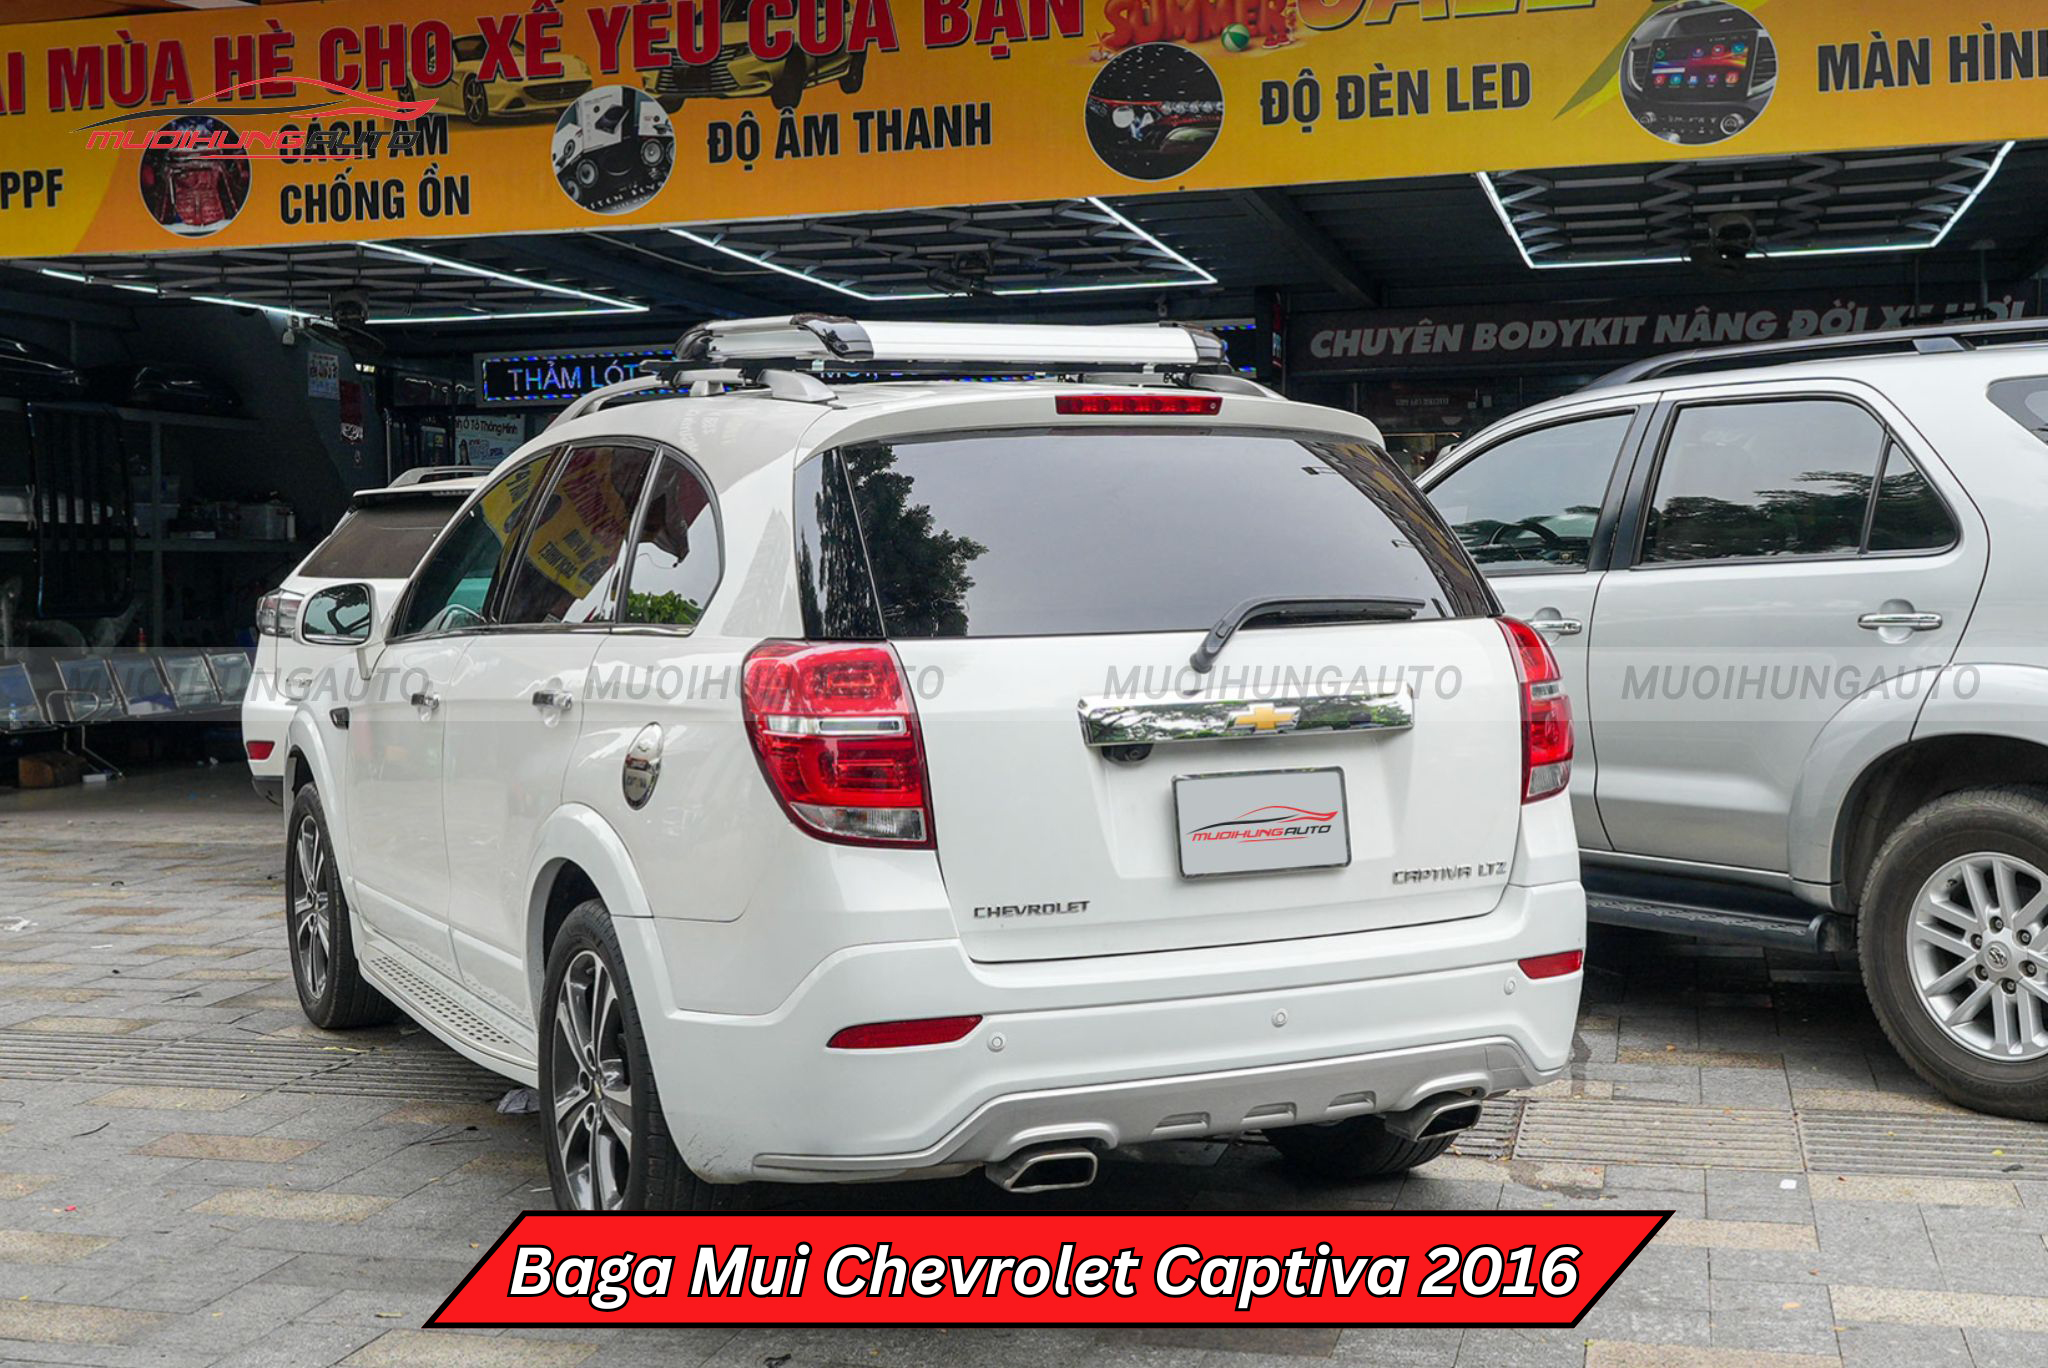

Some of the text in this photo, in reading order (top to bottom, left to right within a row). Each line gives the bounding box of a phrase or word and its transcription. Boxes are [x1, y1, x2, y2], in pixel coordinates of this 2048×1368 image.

[0, 52, 25, 116] I
[48, 30, 195, 112] MÙA
[213, 19, 296, 101] HÈ
[319, 20, 453, 96] CHO
[1817, 31, 1931, 93] MÀN
[1259, 62, 1531, 133] ĐỘ ĐÈN LED
[707, 102, 992, 171] ĐỘ ÂM THANH
[0, 168, 64, 210] PPF
[280, 163, 471, 225] CHỐNG ỒN
[1310, 318, 1463, 358] CHUYÊN
[1472, 314, 1647, 352] BODYKIT
[1653, 306, 1777, 343] NÂNG
[1788, 300, 1868, 336] ĐỜI
[508, 360, 641, 391] THẢM LÓT
[1392, 861, 1507, 885] CAPTIVA LTZ
[973, 900, 1091, 919] CHEVROLET
